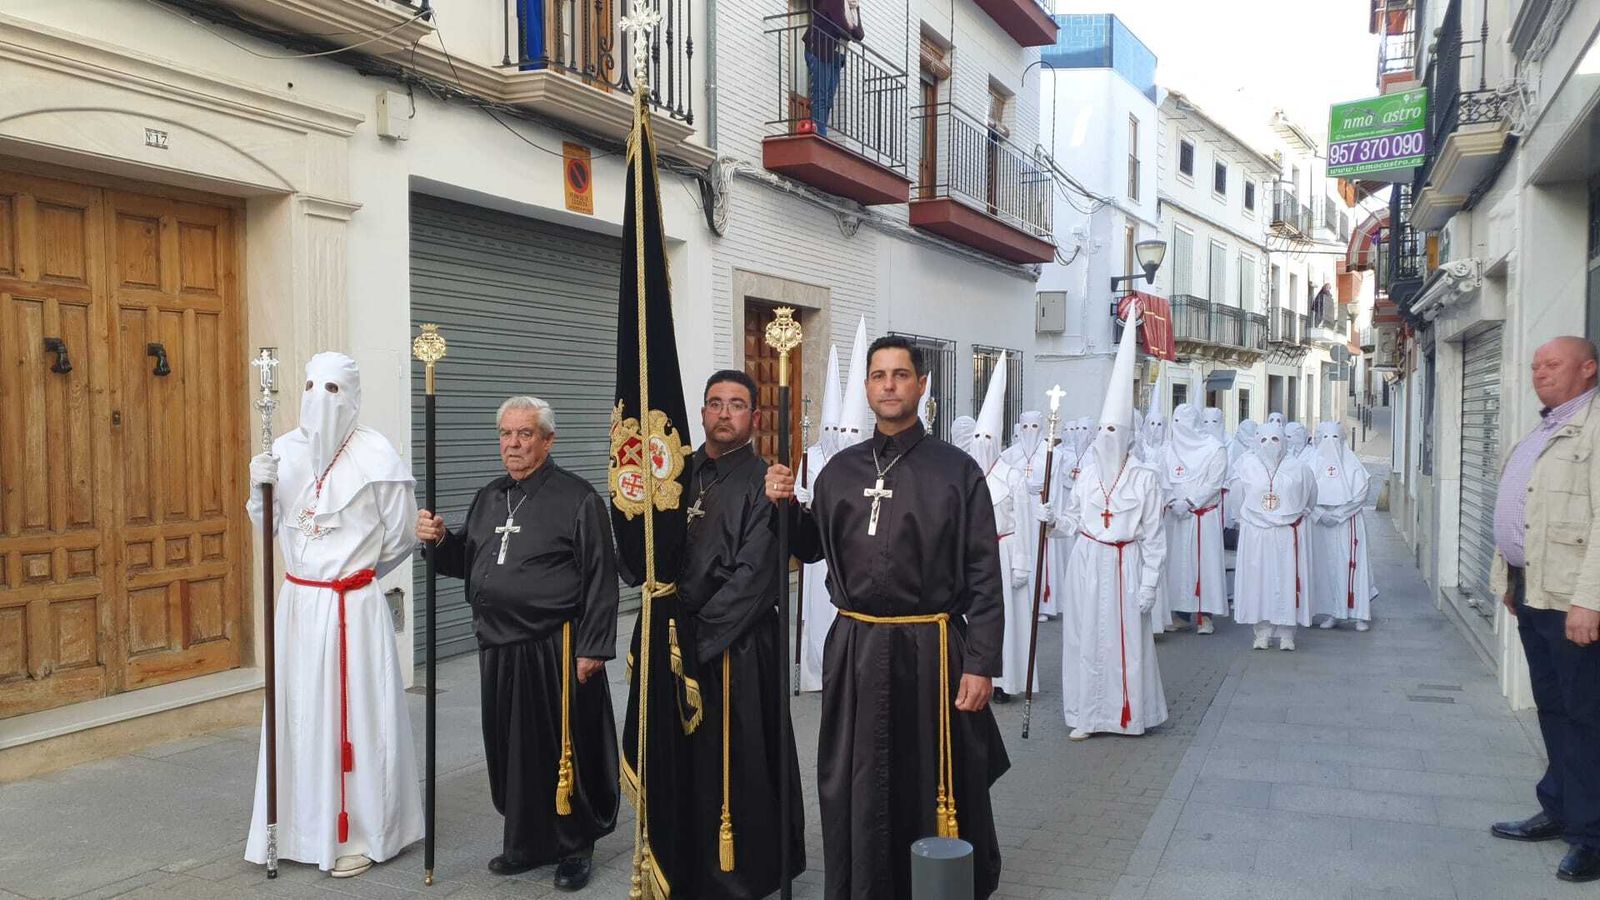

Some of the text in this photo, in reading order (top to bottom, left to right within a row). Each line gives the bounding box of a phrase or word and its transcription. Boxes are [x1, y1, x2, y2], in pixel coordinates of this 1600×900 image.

[155, 134, 167, 147] 17
[1330, 142, 1358, 165] 957
[1360, 138, 1389, 161] 370
[1392, 133, 1423, 156] 090
